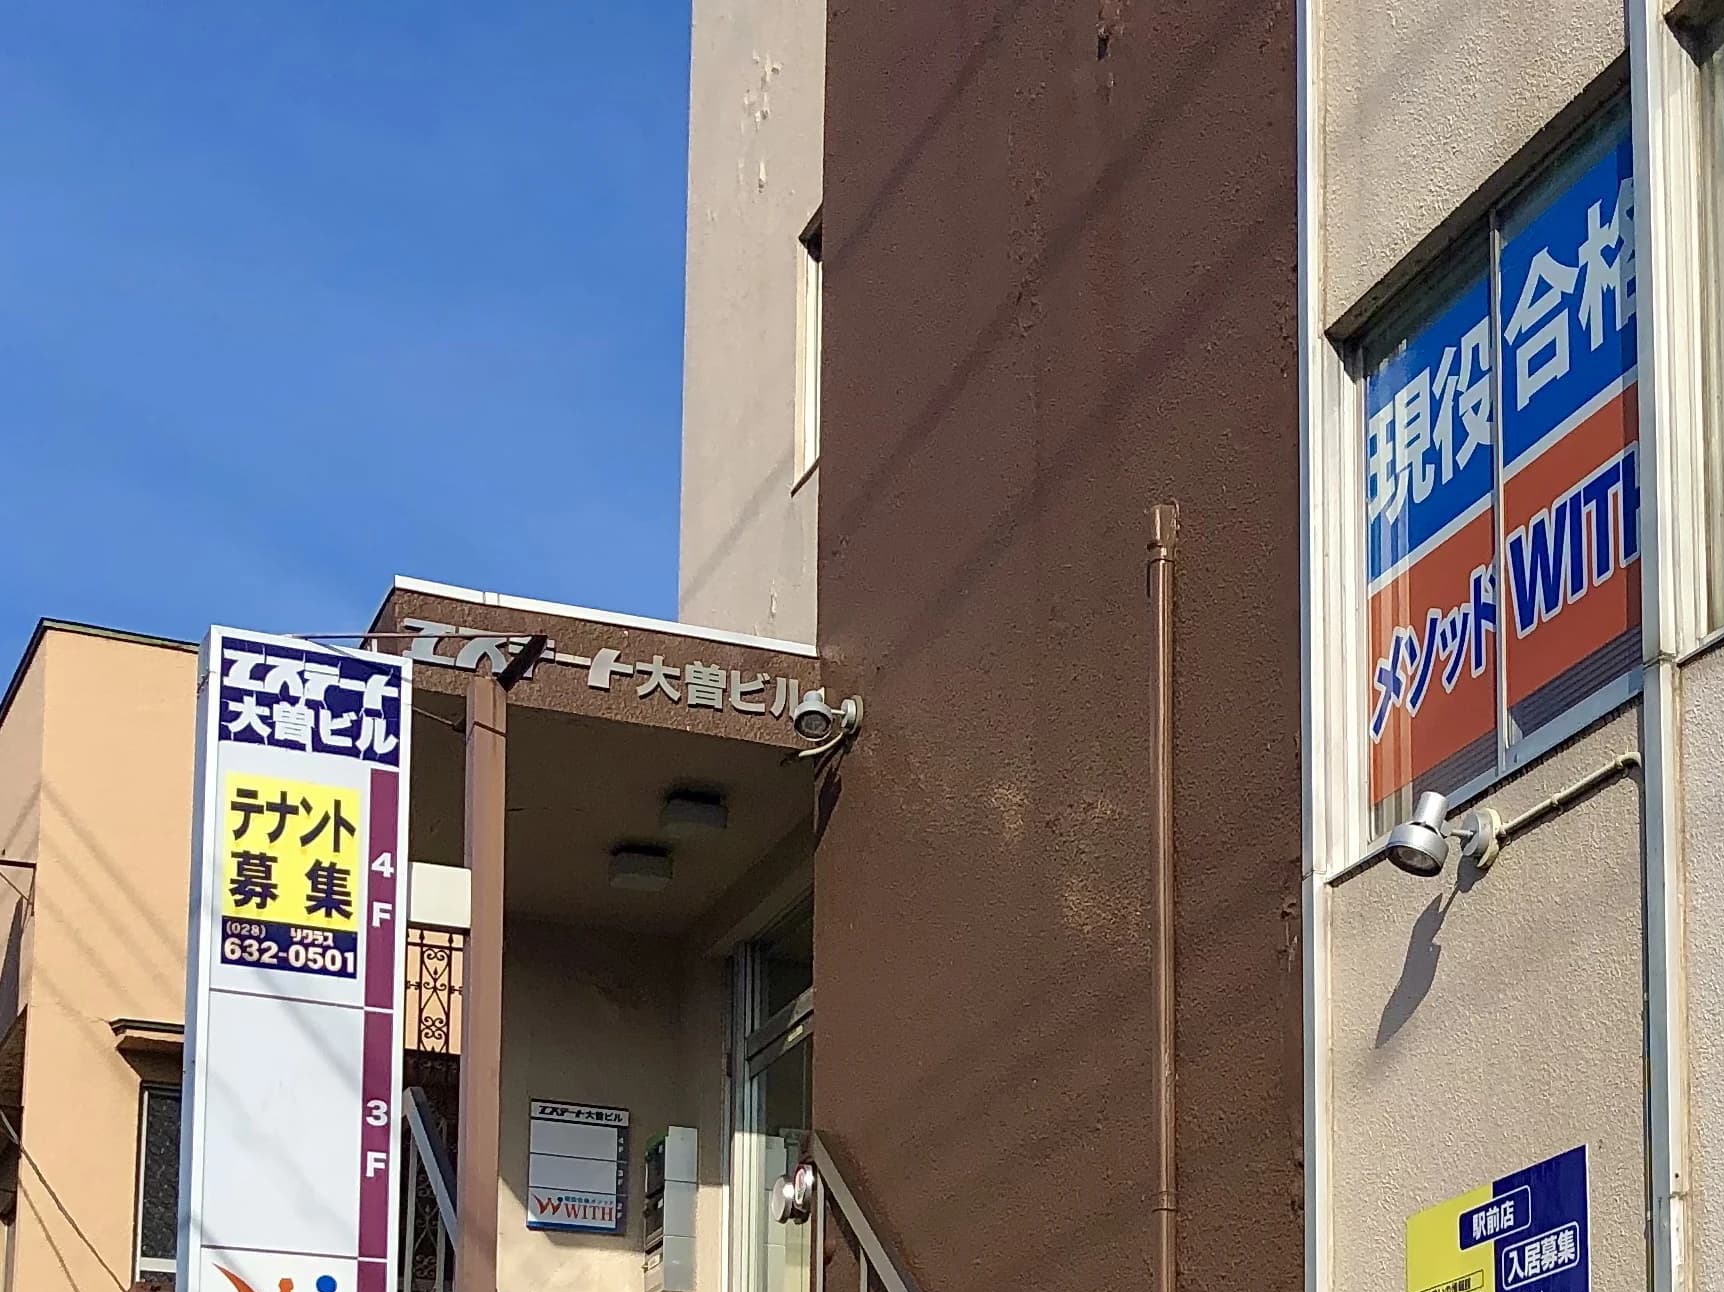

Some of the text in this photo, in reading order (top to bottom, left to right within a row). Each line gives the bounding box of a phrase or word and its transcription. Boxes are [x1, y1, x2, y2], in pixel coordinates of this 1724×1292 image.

[223, 648, 399, 709] エステート
[227, 695, 399, 755] 大曽ビル
[230, 787, 357, 853] テナント
[229, 851, 354, 919] 募集
[223, 937, 355, 974] 632-0501
[226, 921, 334, 947] (028) リクラス
[563, 1202, 614, 1221] WITH
[1472, 1200, 1515, 1240] 駅前店
[1507, 1229, 1576, 1283] 入居募集
